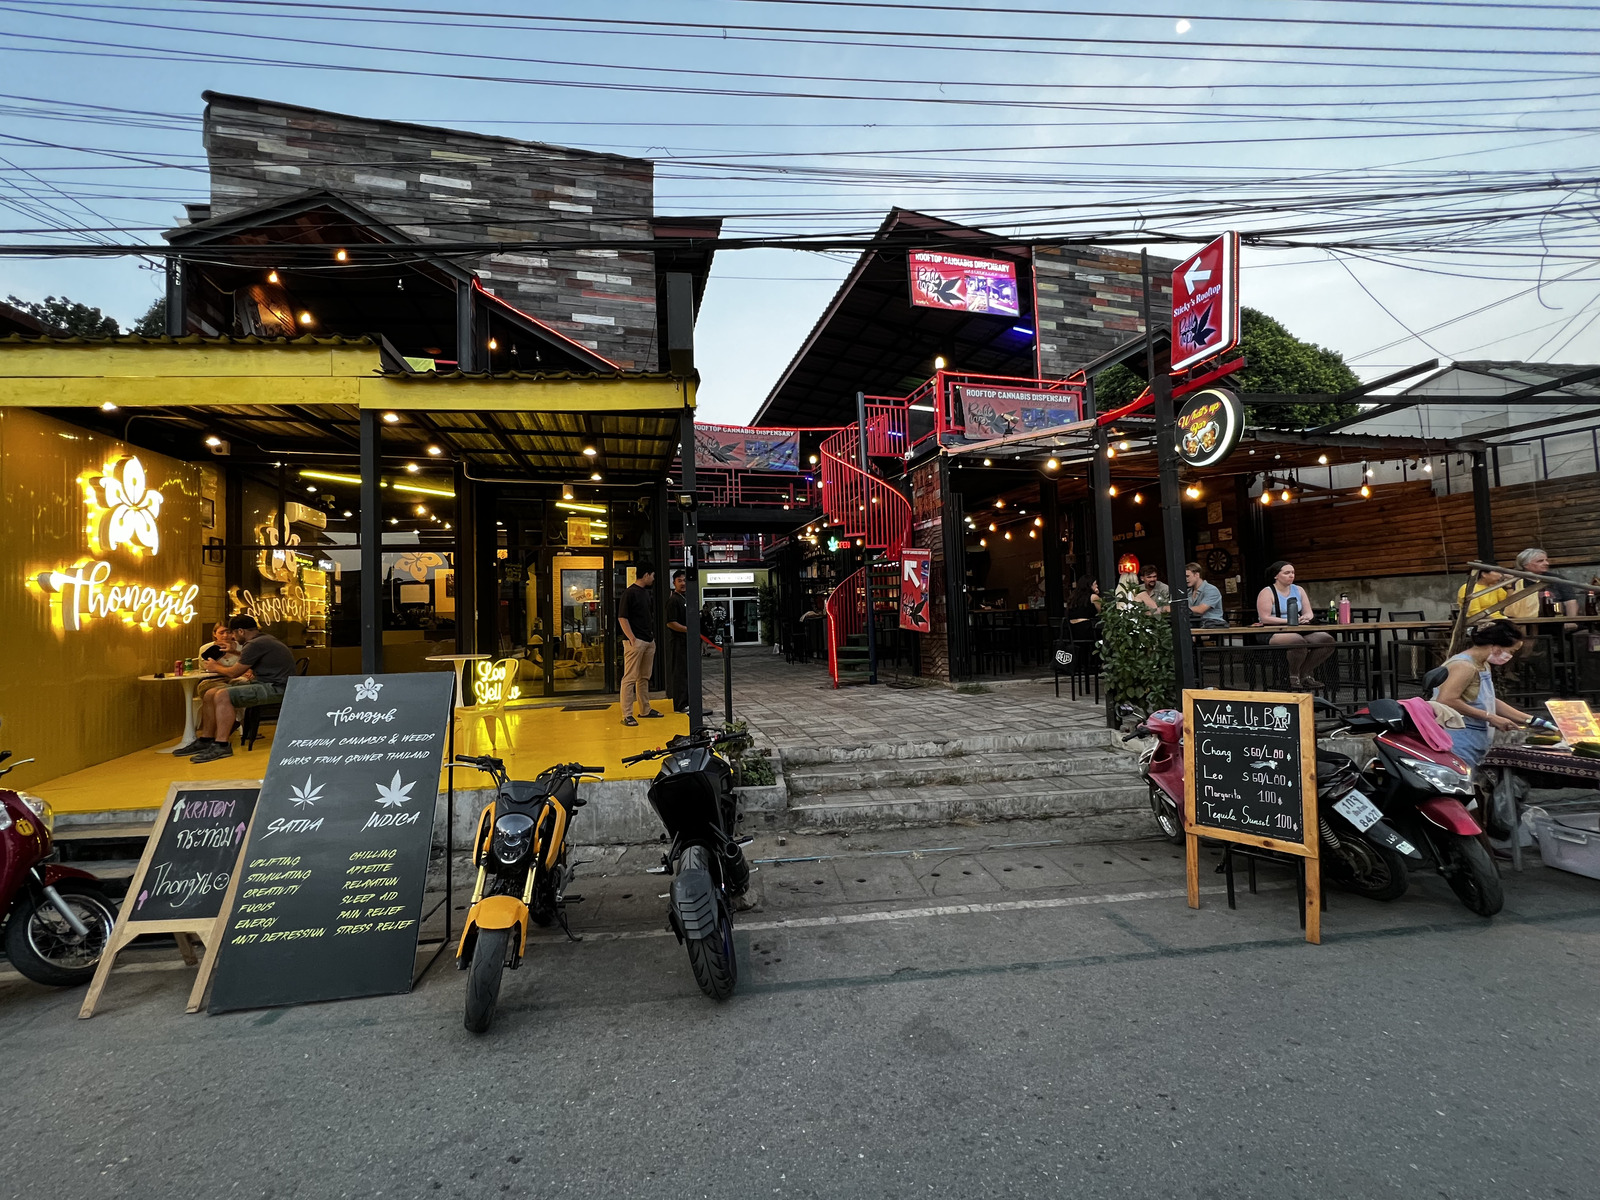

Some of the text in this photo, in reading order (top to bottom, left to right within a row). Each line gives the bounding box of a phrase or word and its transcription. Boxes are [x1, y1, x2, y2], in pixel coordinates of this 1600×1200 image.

[915, 253, 1010, 273] ROOFTOP CANNABIS DISPENSARY
[1173, 284, 1221, 318] Sticky's Rooftop
[966, 389, 1071, 403] ROOFTOP CANNABIS DISPENSARY
[722, 427, 755, 435] CANNABIS
[1190, 420, 1208, 437] Bar
[836, 541, 851, 549] OPEN
[49, 561, 199, 631] Thongyib
[475, 681, 521, 705] Yellw
[326, 706, 397, 726] Thongyib
[287, 732, 436, 748] PREMIUM CANNABIS & WEEDS
[279, 750, 430, 766] WORKS FROM GROWER THAILAND
[1201, 739, 1232, 763] Chang
[1203, 765, 1223, 780] Leo
[1204, 785, 1277, 804] Margarita 100
[183, 800, 236, 820] KRATOM
[1202, 801, 1292, 830] Tequila Sunset 100
[361, 811, 421, 833] INDICA
[1359, 809, 1380, 828] 8427
[258, 817, 325, 842] SATIVA
[249, 856, 301, 868] UPLIFTING
[349, 849, 397, 861] CHILLING
[245, 869, 311, 883] STIMULATING
[346, 863, 394, 874] APPETITE
[341, 877, 400, 890] RELAXATION
[243, 885, 302, 899] CREATIVITY
[339, 891, 399, 905] SLEEP AID
[237, 901, 275, 913] FOCUS
[336, 905, 406, 920] PAIN RELIEF
[234, 917, 279, 930] ENERGY
[333, 919, 416, 936] STRESS RELIEF
[231, 928, 327, 945] ANTI DEPRESSION
